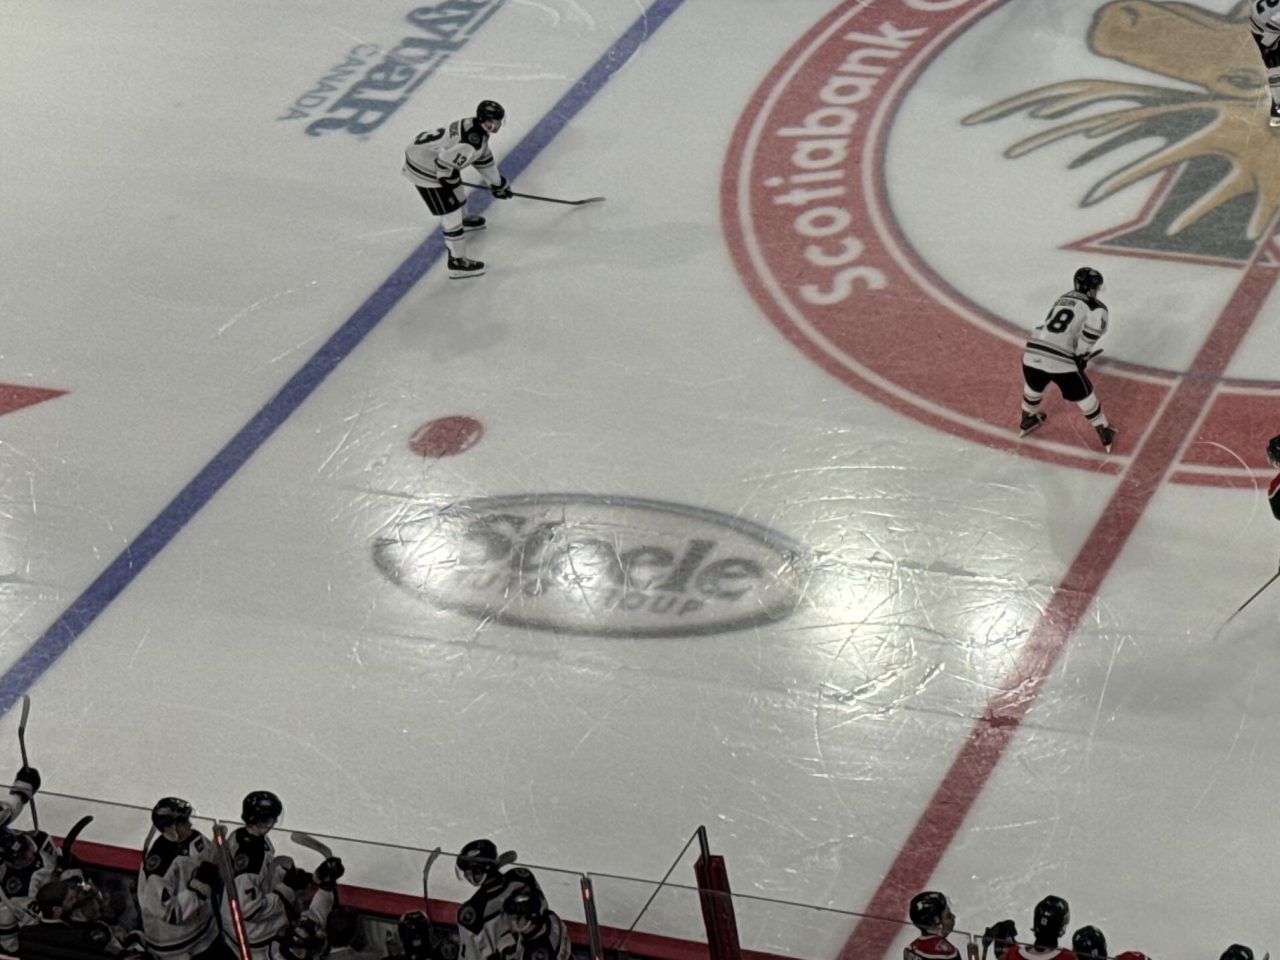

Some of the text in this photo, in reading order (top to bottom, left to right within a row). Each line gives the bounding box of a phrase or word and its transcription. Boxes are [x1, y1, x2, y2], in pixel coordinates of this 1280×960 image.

[276, 43, 379, 121] CANADA
[761, 21, 928, 306] Scotiabank
[1040, 308, 1076, 334] 8
